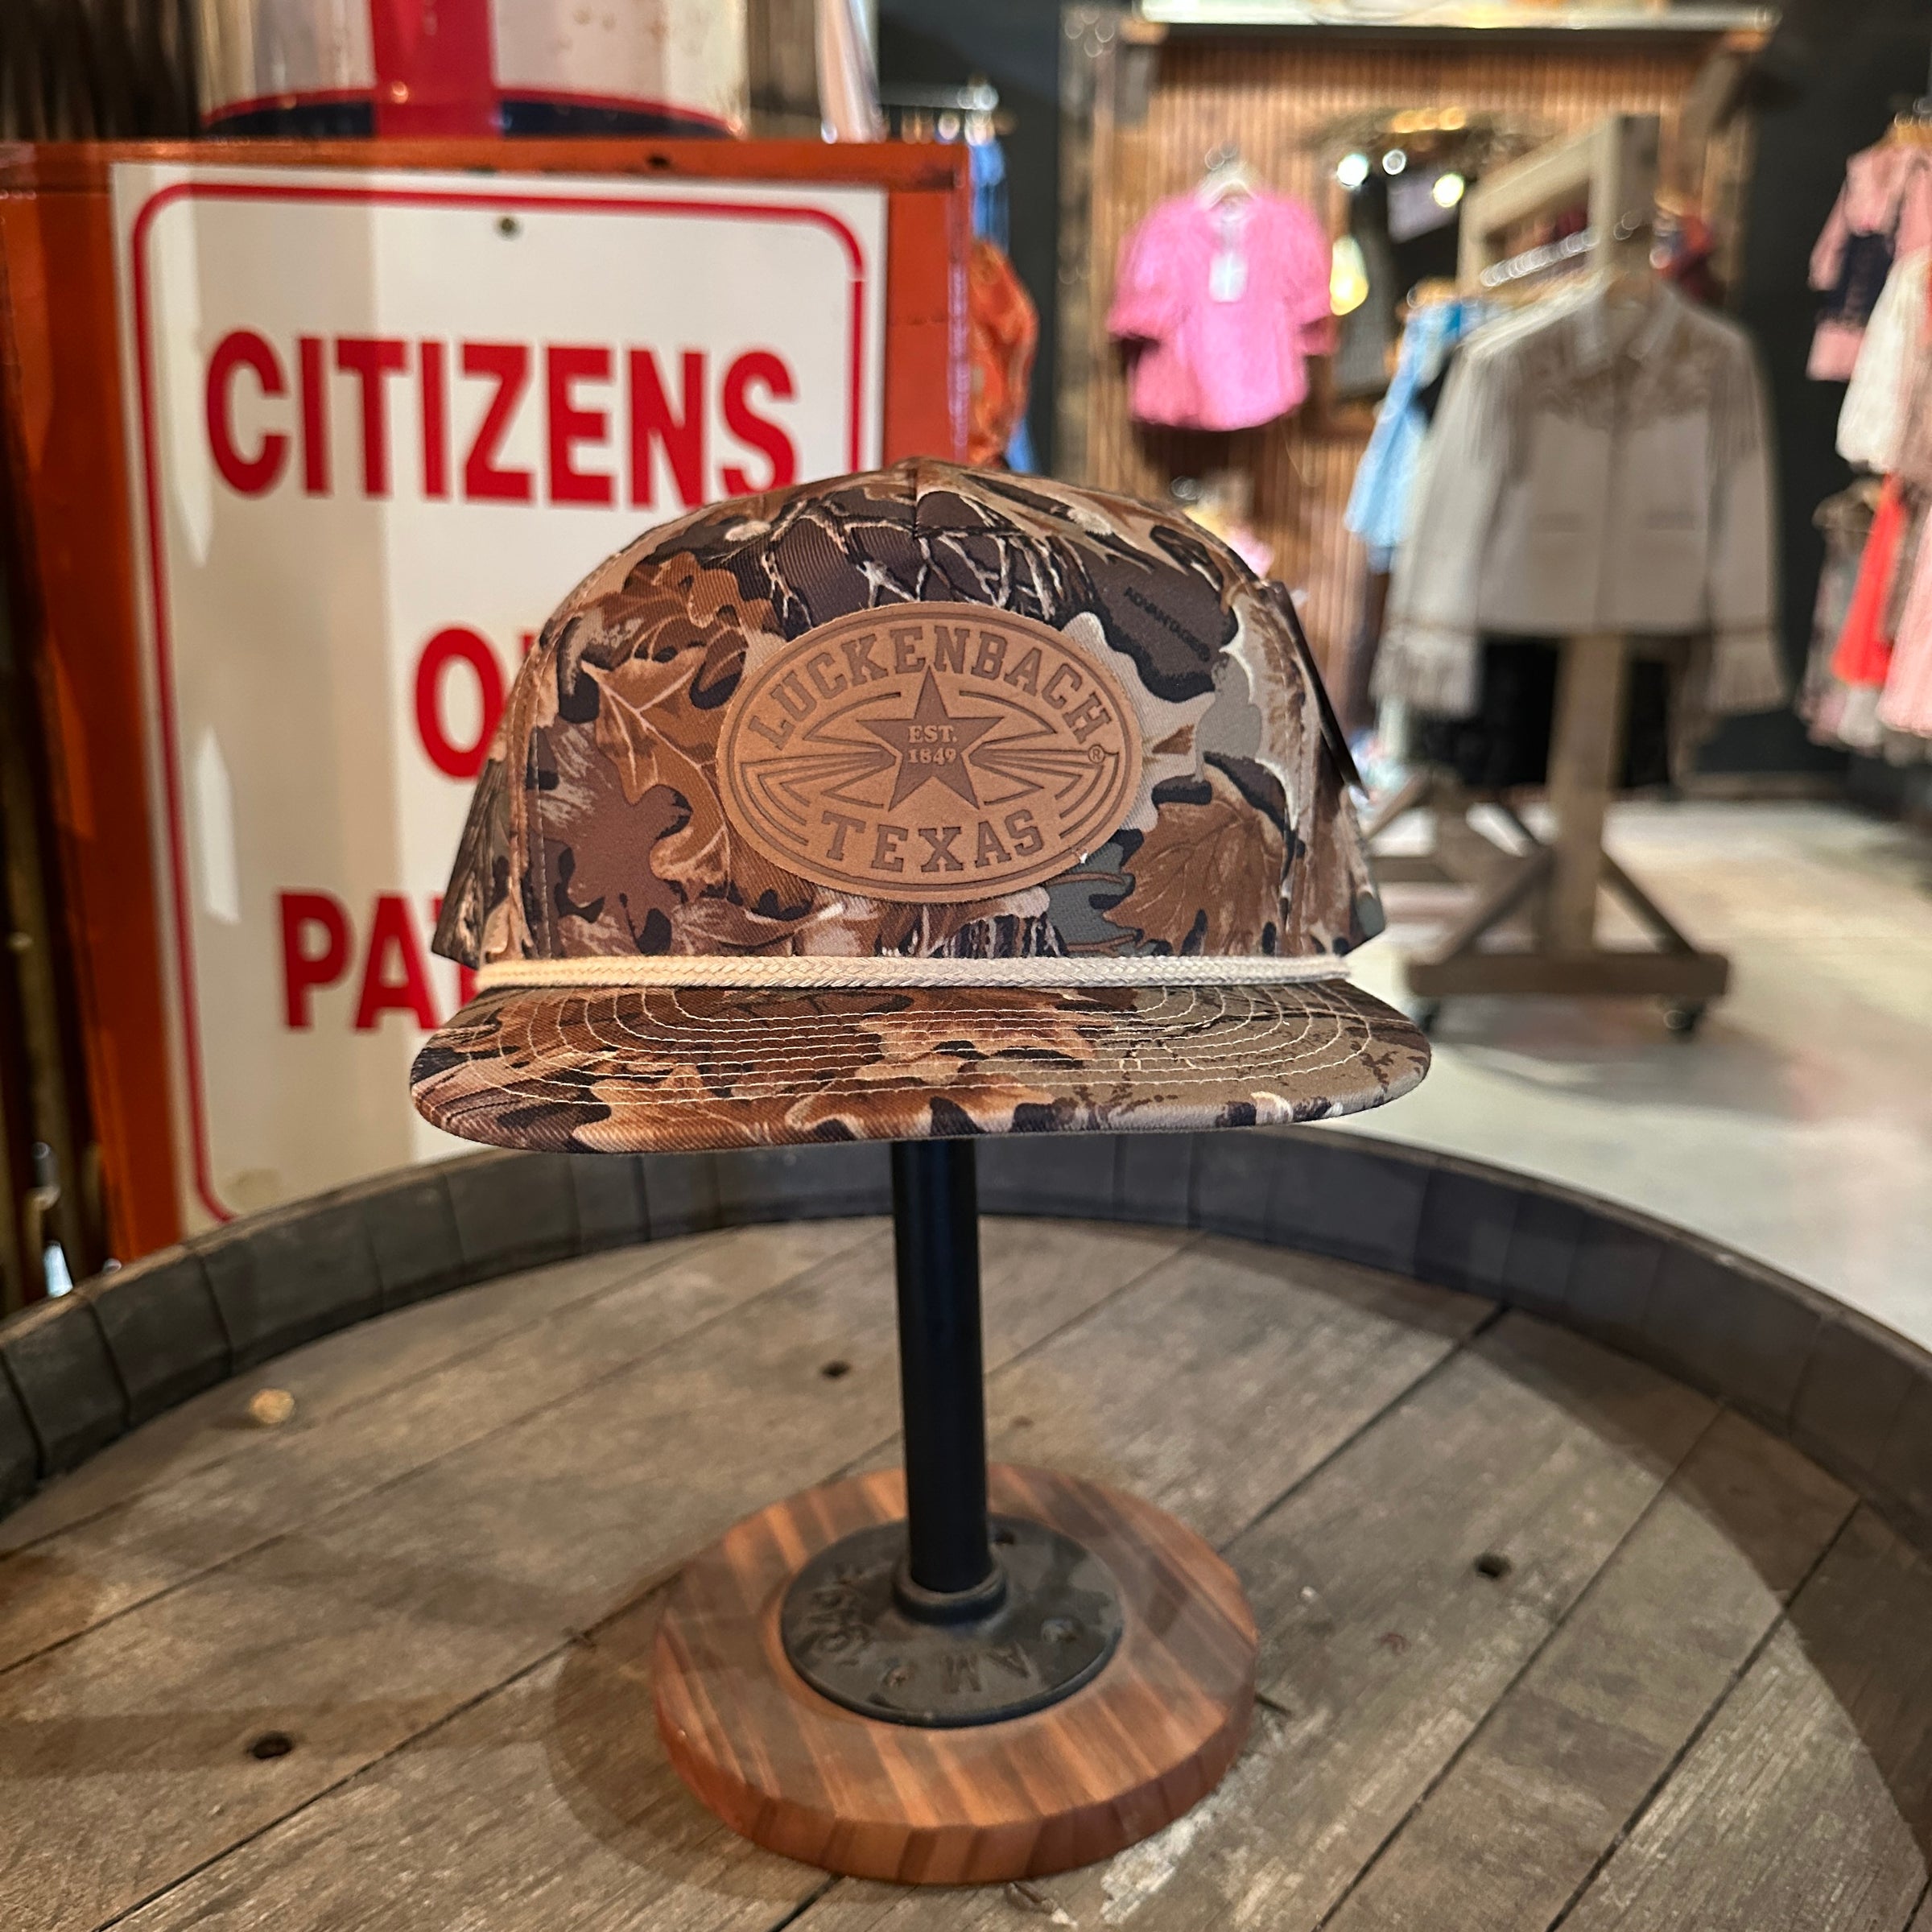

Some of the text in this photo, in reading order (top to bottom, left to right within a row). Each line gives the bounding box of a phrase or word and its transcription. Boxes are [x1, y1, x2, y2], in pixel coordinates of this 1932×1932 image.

[205, 330, 800, 509] CITIZENS
[413, 627, 538, 782] O
[750, 625, 1113, 750] LUCKENBACH
[907, 724, 958, 743] EST.
[907, 747, 957, 766] 1849
[820, 807, 1045, 873] TEXAS
